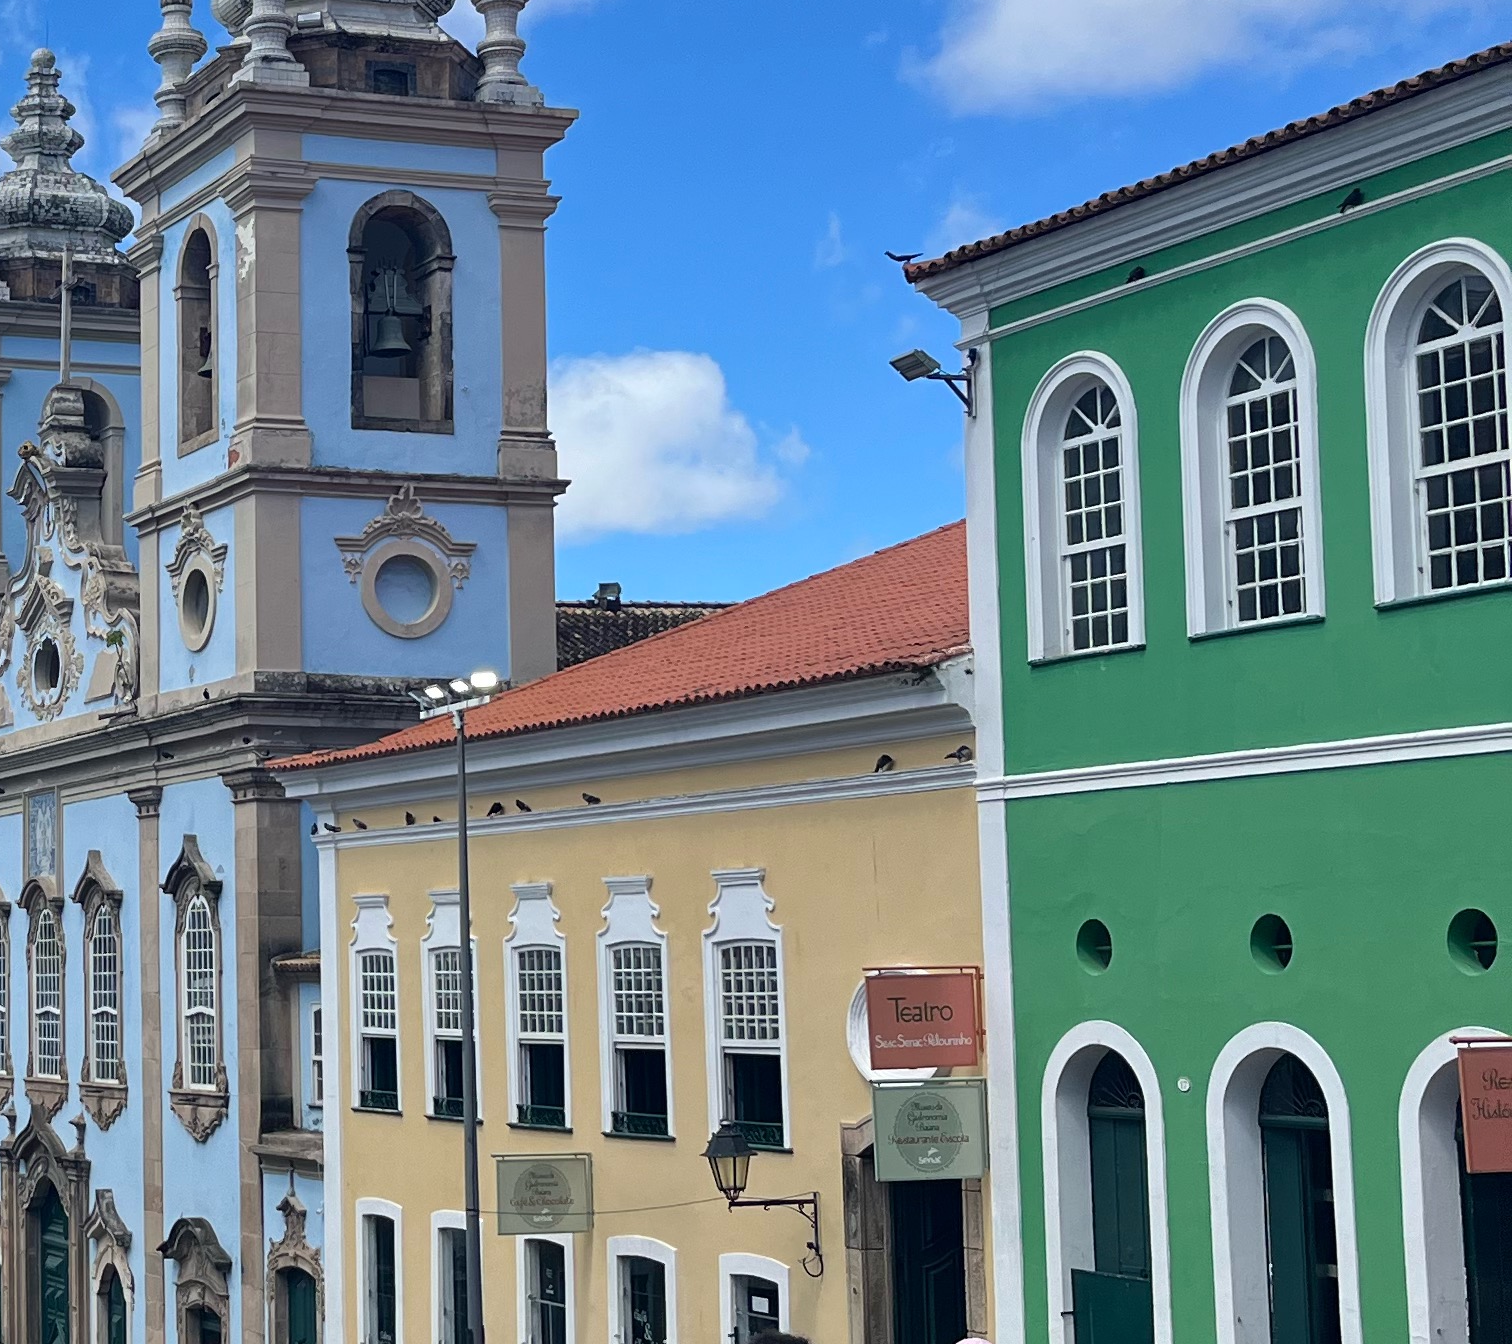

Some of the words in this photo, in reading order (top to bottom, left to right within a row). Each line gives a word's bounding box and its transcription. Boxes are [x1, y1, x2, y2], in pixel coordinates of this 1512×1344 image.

[886, 997, 954, 1024] Teatro
[897, 1034, 923, 1048] Senac
[923, 1032, 972, 1047] Pelourinho
[1482, 1068, 1512, 1091] Re
[1470, 1096, 1512, 1120] Histó
[644, 1322, 653, 1341] &
